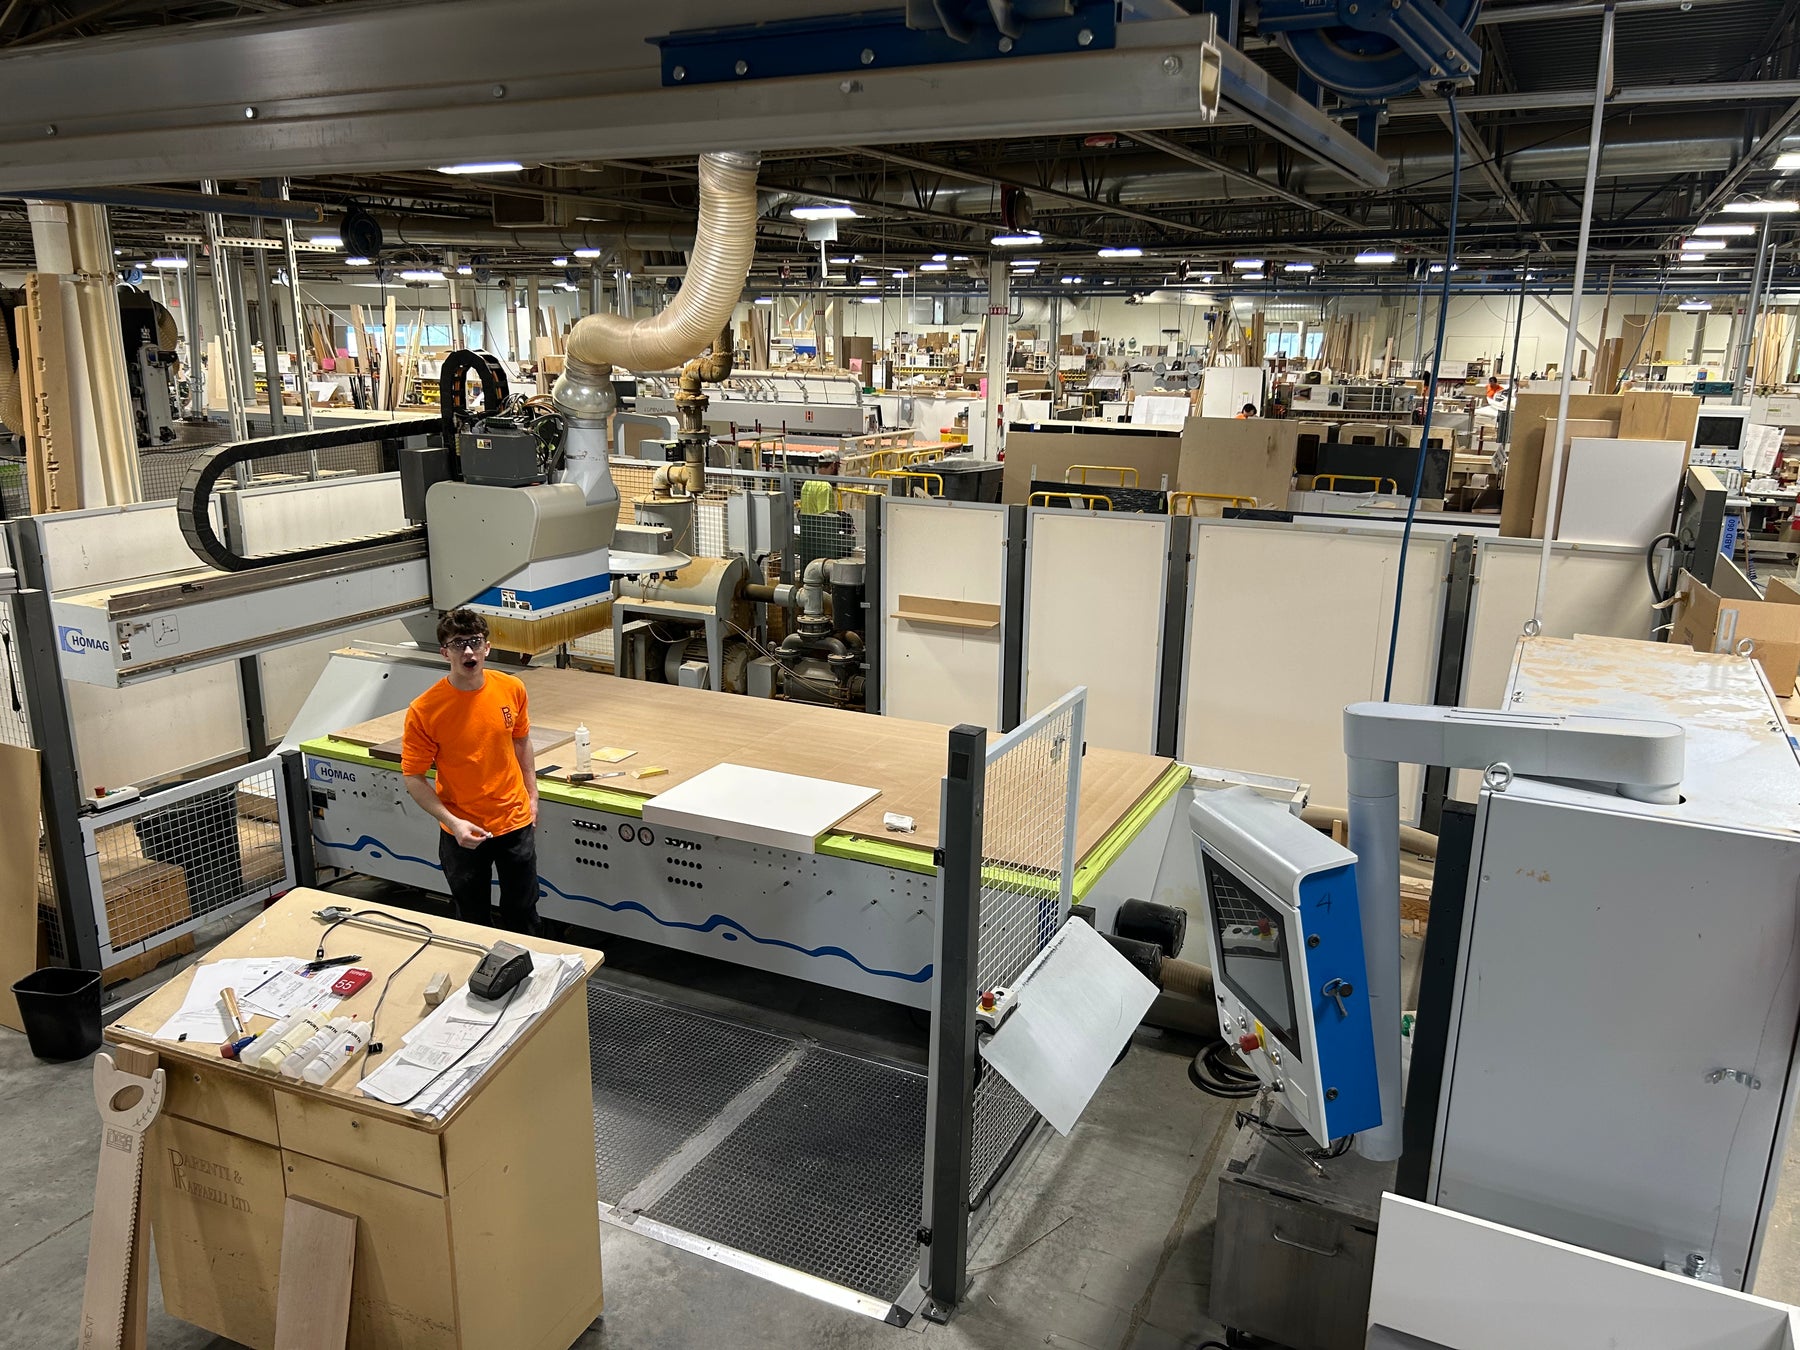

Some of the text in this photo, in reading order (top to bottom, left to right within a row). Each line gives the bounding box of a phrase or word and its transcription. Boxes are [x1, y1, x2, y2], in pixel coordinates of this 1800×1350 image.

[1724, 519, 1736, 550] ABD 060
[71, 635, 110, 652] HOMAG
[320, 766, 356, 782] HOMAG
[1316, 892, 1333, 914] 4
[335, 979, 355, 990] 55
[233, 1169, 245, 1186] &
